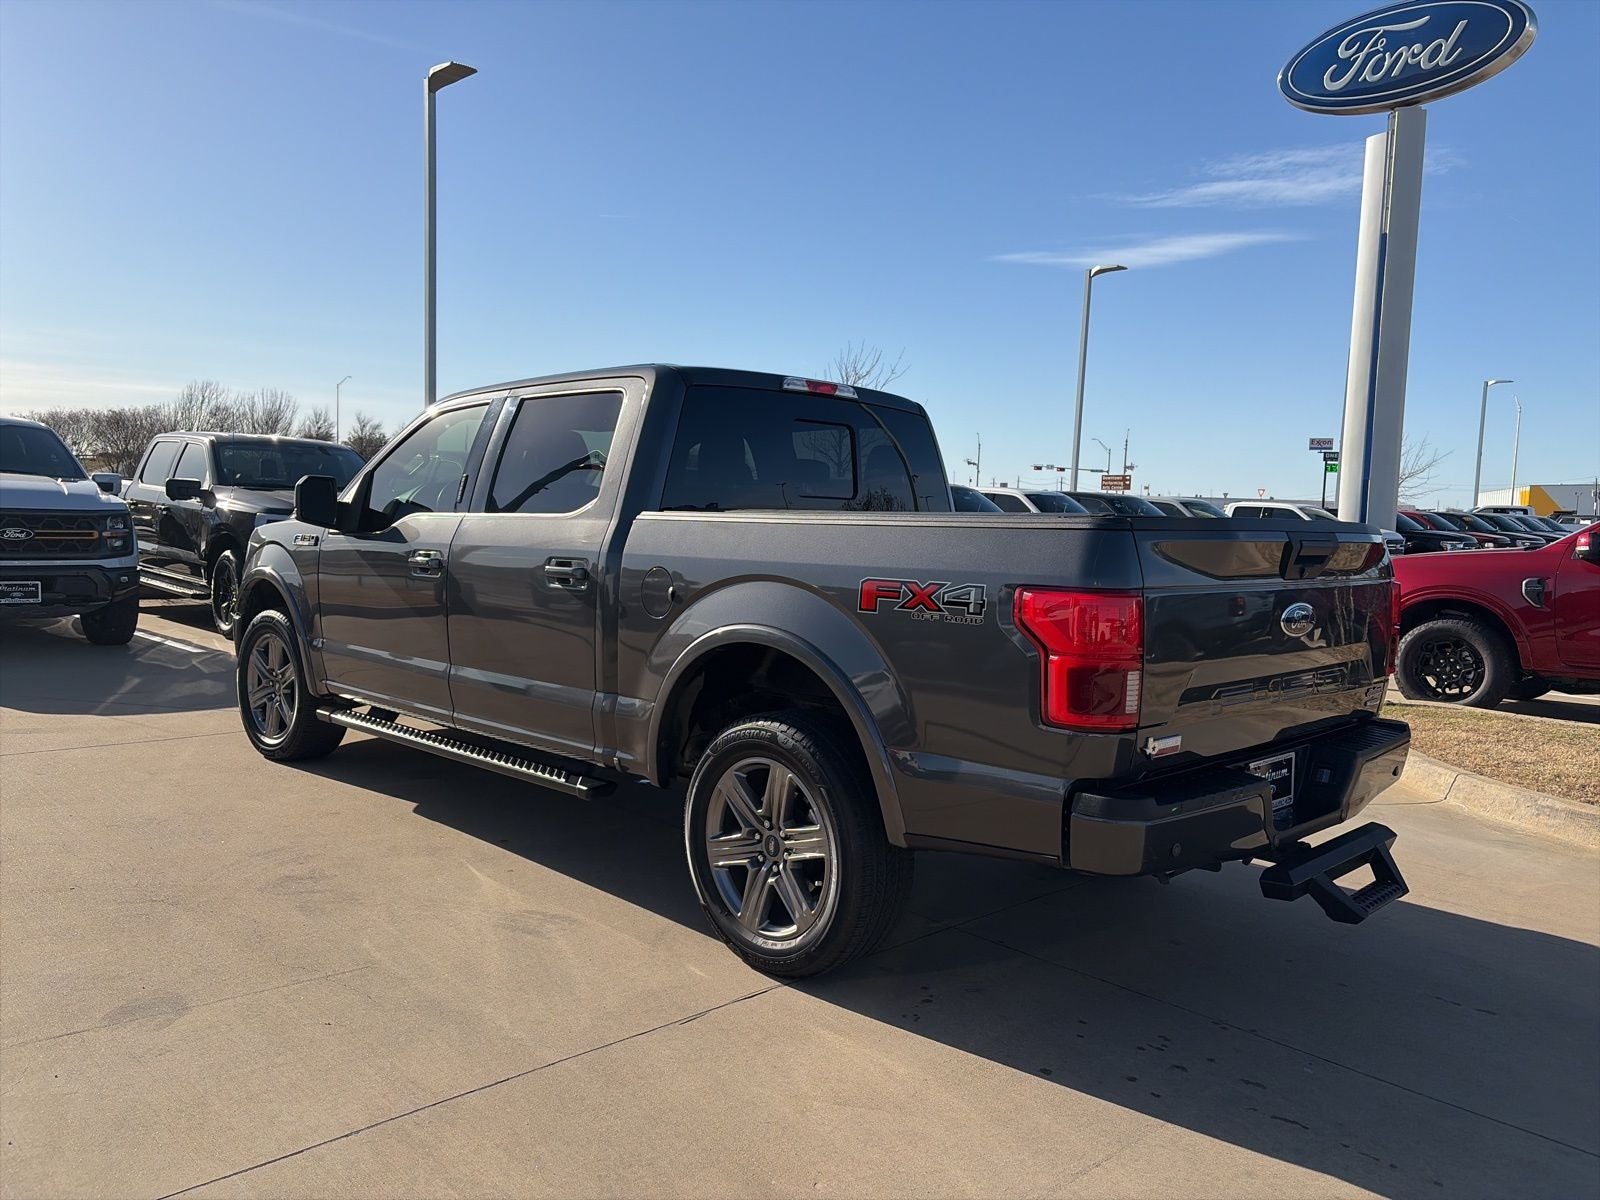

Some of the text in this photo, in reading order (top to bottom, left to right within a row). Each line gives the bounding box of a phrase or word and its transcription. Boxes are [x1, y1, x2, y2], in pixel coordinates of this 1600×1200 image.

[1323, 15, 1469, 92] Ford
[1311, 439, 1332, 447] Exxon
[3, 529, 27, 538] Ford
[857, 576, 987, 618] FX4
[911, 612, 985, 625] OFF ROAD
